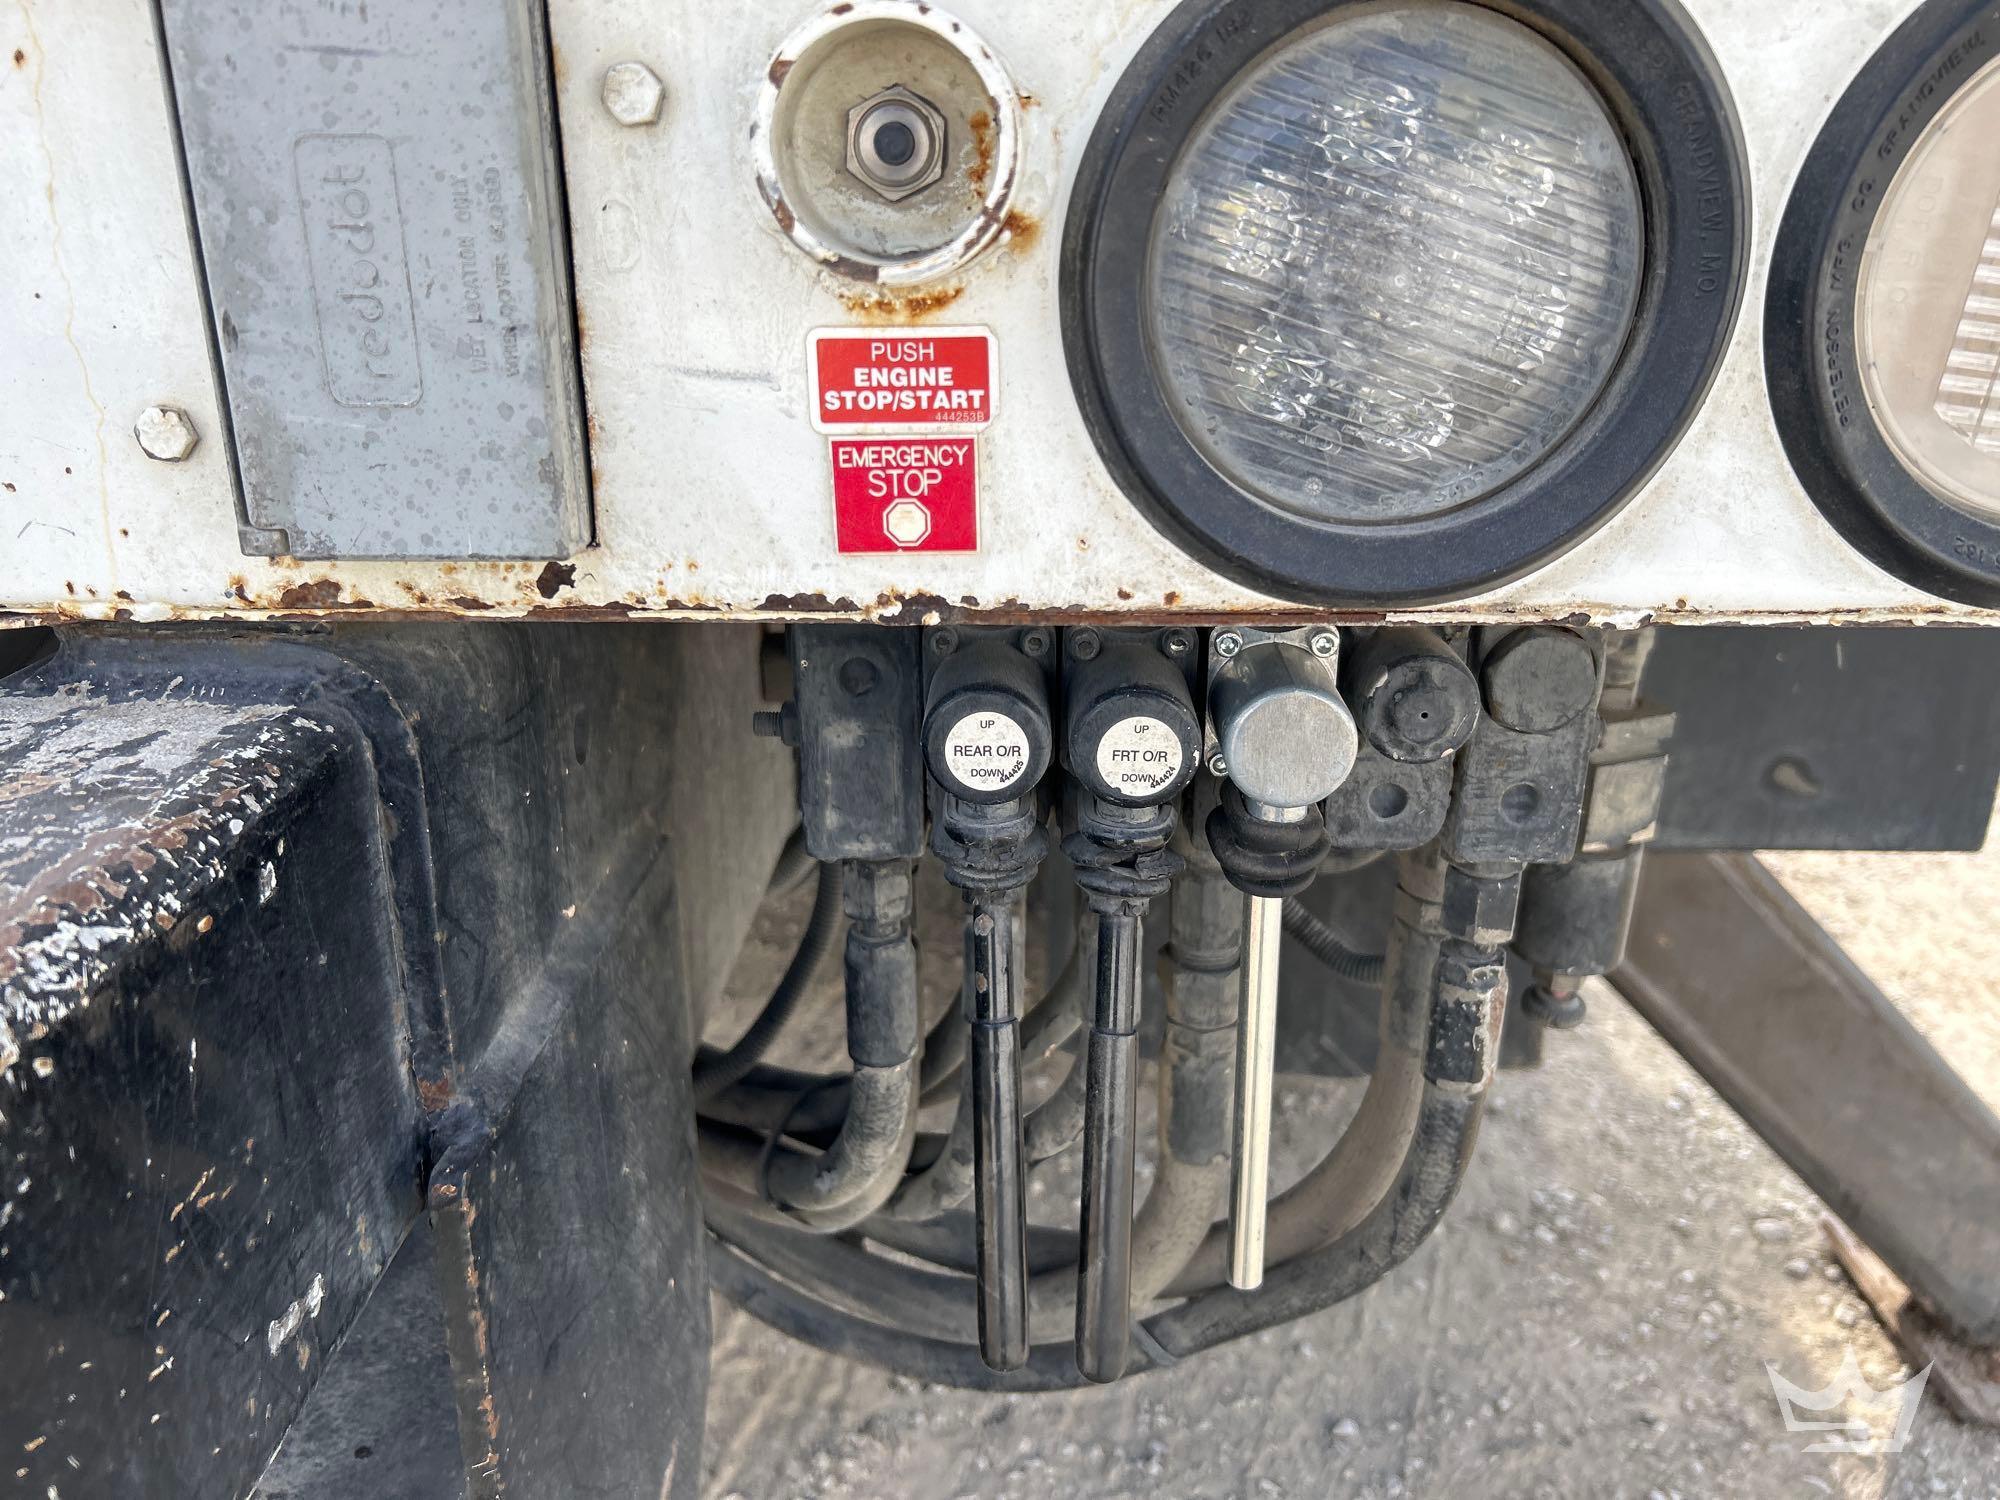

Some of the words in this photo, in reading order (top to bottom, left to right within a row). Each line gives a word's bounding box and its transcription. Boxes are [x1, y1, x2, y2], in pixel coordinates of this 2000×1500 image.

[871, 342, 934, 361] PUSH
[854, 367, 954, 387] ENGINE
[824, 389, 985, 411] STOP/START
[935, 411, 985, 422] 444253B
[838, 445, 969, 468] EMERGENCY
[868, 469, 942, 497] STOP
[980, 720, 995, 729] UP
[1134, 725, 1150, 734] UP
[953, 745, 992, 757] REAR
[996, 745, 1021, 757] O/R
[1112, 749, 1140, 761] FRT
[1142, 750, 1168, 762] O/R
[970, 768, 1005, 778] DOWN
[999, 760, 1024, 783] 444425
[1121, 773, 1156, 783] DOWN
[1150, 766, 1176, 788] 444424
